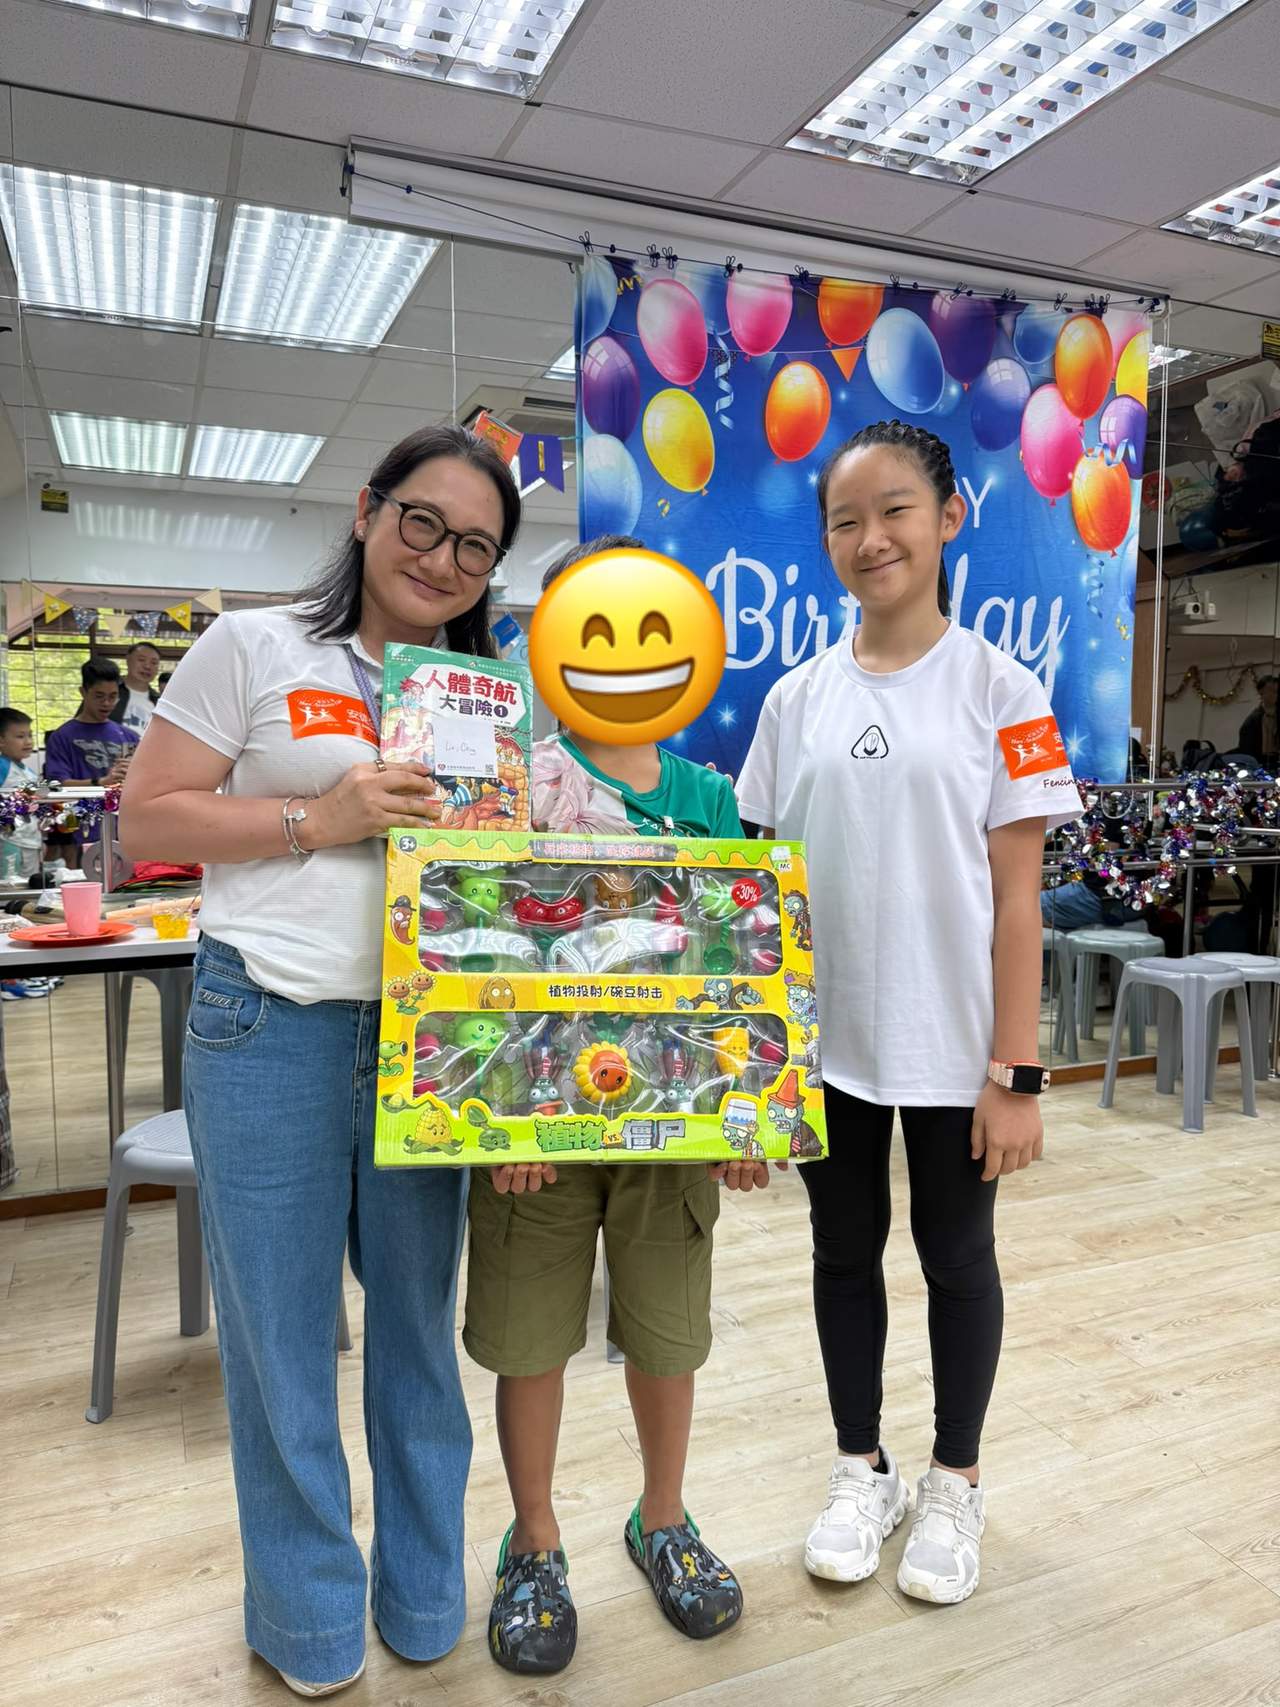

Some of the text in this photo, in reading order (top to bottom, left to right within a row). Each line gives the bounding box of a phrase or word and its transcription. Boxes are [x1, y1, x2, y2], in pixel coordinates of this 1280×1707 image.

[424, 669, 517, 705] 人體奇航
[401, 837, 416, 850] 3+
[736, 885, 758, 902] -30%
[535, 1119, 607, 1152] 植物
